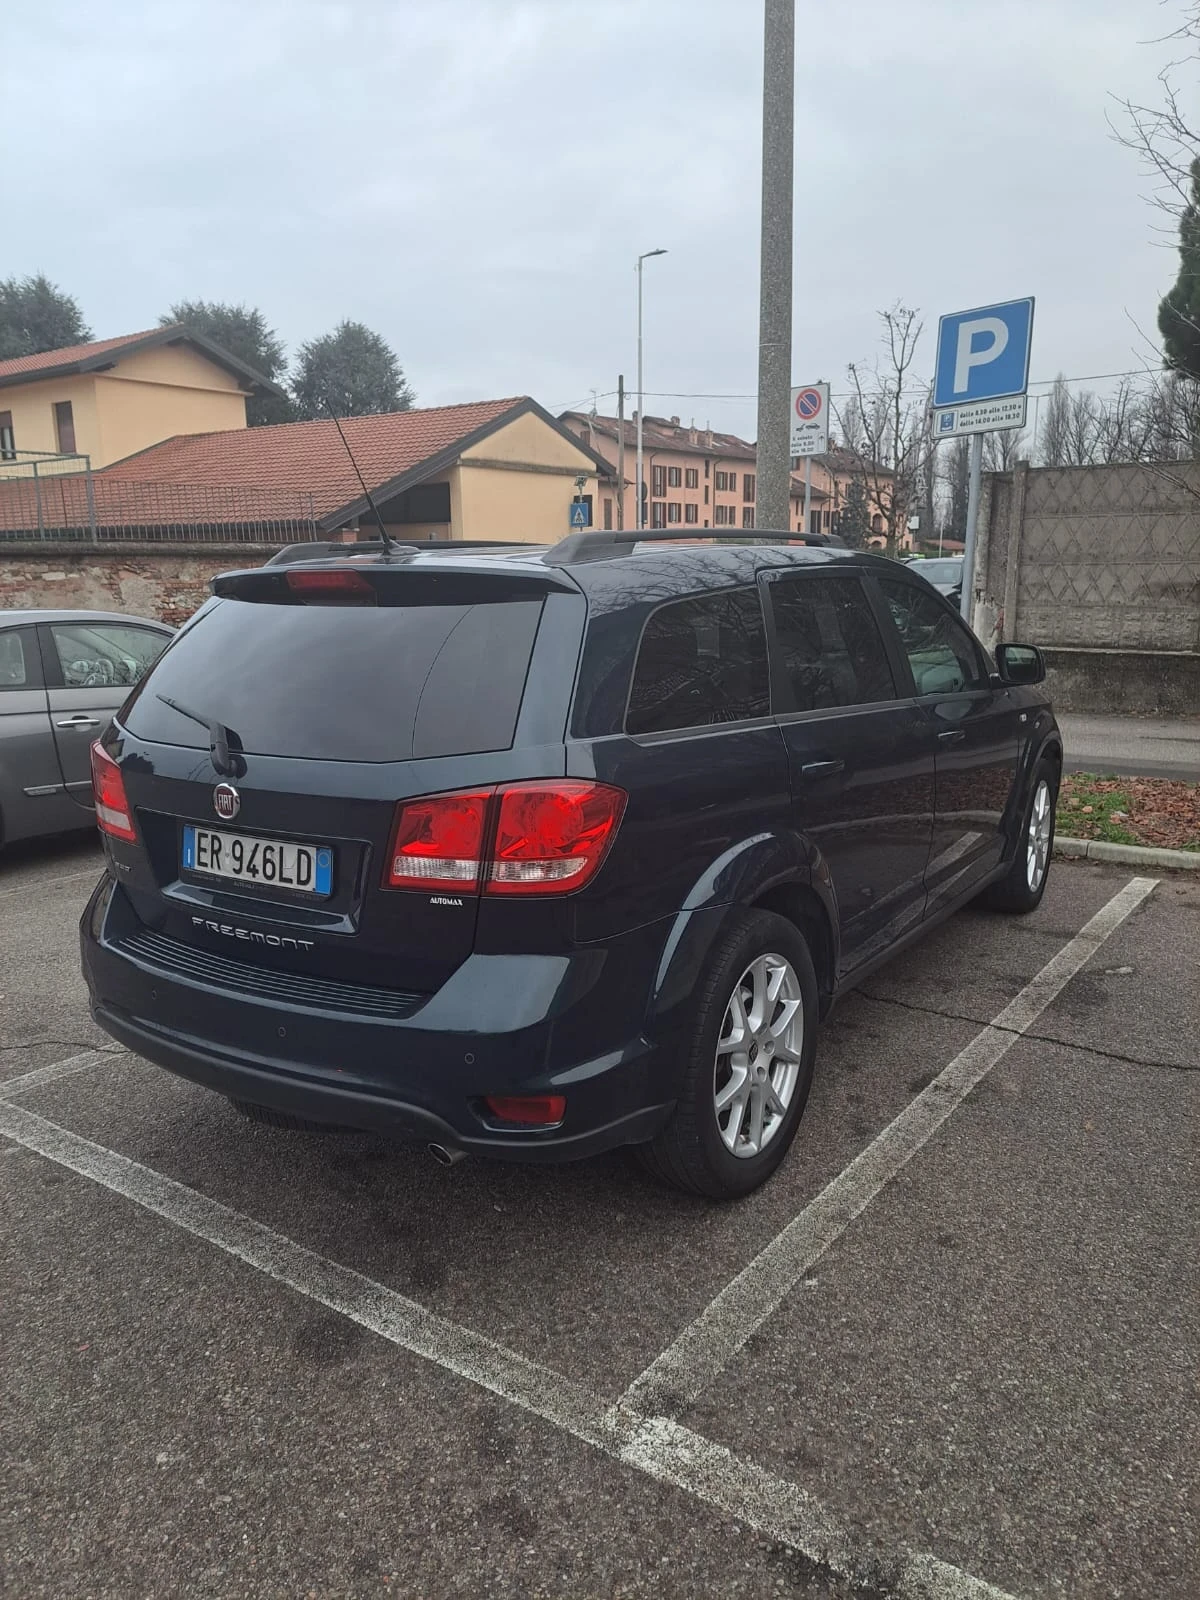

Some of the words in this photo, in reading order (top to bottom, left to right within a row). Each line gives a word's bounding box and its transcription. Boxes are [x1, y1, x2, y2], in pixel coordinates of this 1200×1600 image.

[953, 317, 1009, 394] P
[218, 794, 232, 811] FIAT
[430, 897, 463, 906] AUTOMAX
[191, 916, 314, 951] FREEMONT
